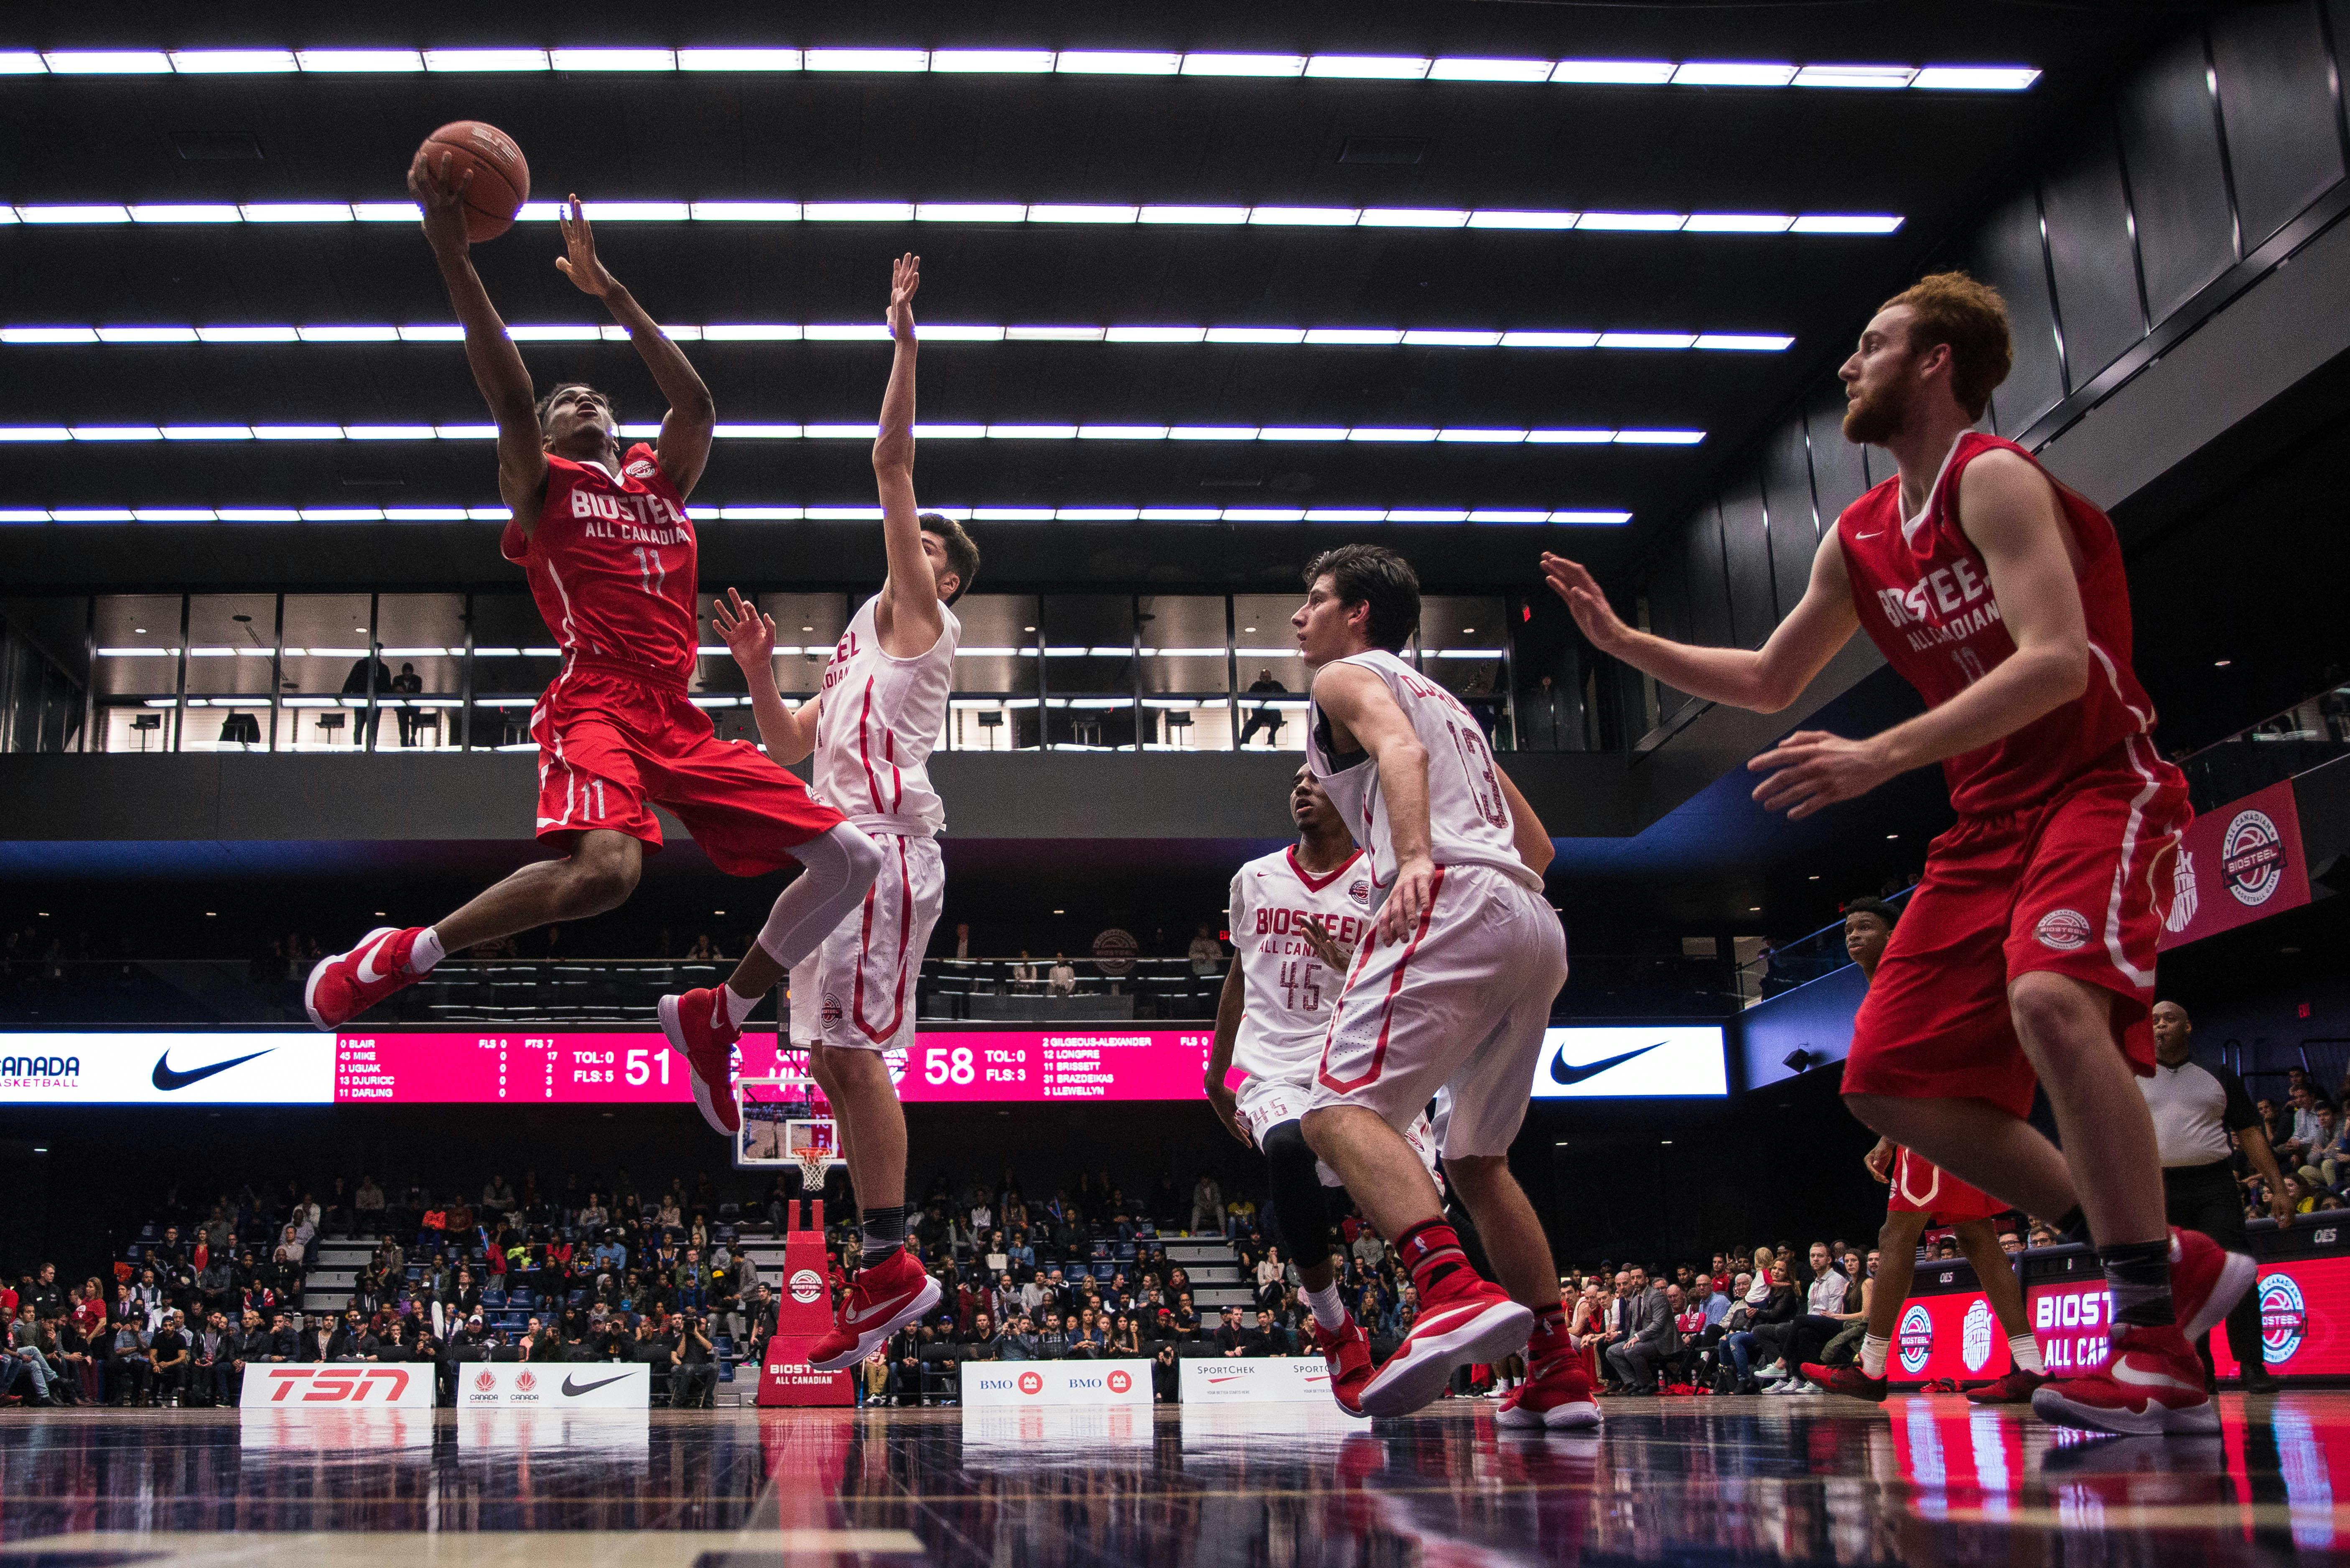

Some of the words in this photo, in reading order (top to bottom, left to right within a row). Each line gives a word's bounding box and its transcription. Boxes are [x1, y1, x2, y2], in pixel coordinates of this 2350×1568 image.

[586, 522, 615, 538] ALL
[633, 546, 665, 597] 11
[829, 631, 861, 666] EL
[822, 665, 850, 690] DIAN
[1446, 719, 1509, 829] 13
[581, 779, 605, 820] 11
[2235, 814, 2271, 830] CANADIAN
[2228, 849, 2277, 872] BIOSTEEL
[1258, 940, 1279, 954] ALL
[1280, 961, 1323, 1011] 45
[340, 1039, 346, 1048] 0
[349, 1039, 375, 1048] BLAIR
[479, 1039, 496, 1048] FLS
[500, 1039, 507, 1048] 0
[525, 1039, 543, 1048] PTS
[547, 1039, 553, 1048] 7
[1043, 1038, 1049, 1047] 2
[1050, 1037, 1151, 1047] GILGEOUS-ALEXANDER
[1180, 1037, 1197, 1046] FLS
[1202, 1037, 1208, 1046] 0
[339, 1052, 350, 1060] 45
[353, 1052, 376, 1060] MIKE
[500, 1052, 507, 1060] 0
[547, 1052, 558, 1060] 17
[1044, 1050, 1054, 1059] 12
[1056, 1050, 1100, 1059] LONGPRE
[1202, 1050, 1207, 1058] 1
[0, 1057, 79, 1076] ANADA
[339, 1064, 345, 1072] 3
[348, 1064, 381, 1072] UGUAK
[499, 1064, 507, 1072] 0
[546, 1064, 552, 1073] 2
[625, 1049, 669, 1085] 51
[925, 1047, 975, 1084] 58
[1044, 1062, 1053, 1071] 11
[1057, 1062, 1100, 1071] BRISSETT
[340, 1076, 349, 1085] 13
[499, 1076, 506, 1085] 0
[545, 1076, 552, 1085] 3
[1044, 1075, 1054, 1083] 31
[1057, 1074, 1114, 1083] BRAZDEIKAS
[339, 1088, 348, 1097] 11
[351, 1088, 393, 1097] DARLING
[499, 1088, 506, 1097] 0
[545, 1088, 552, 1097] 8
[1044, 1087, 1050, 1095] 3
[1052, 1086, 1104, 1095] LLEWELLYN
[1253, 1097, 1288, 1124] 45
[2044, 1339, 2071, 1366] ALL
[770, 1365, 843, 1374] BIOST
[792, 1376, 832, 1384] CANADIAN
[980, 1380, 1013, 1389] BMO
[1069, 1379, 1102, 1388] BMO
[268, 1369, 409, 1401] TSN
